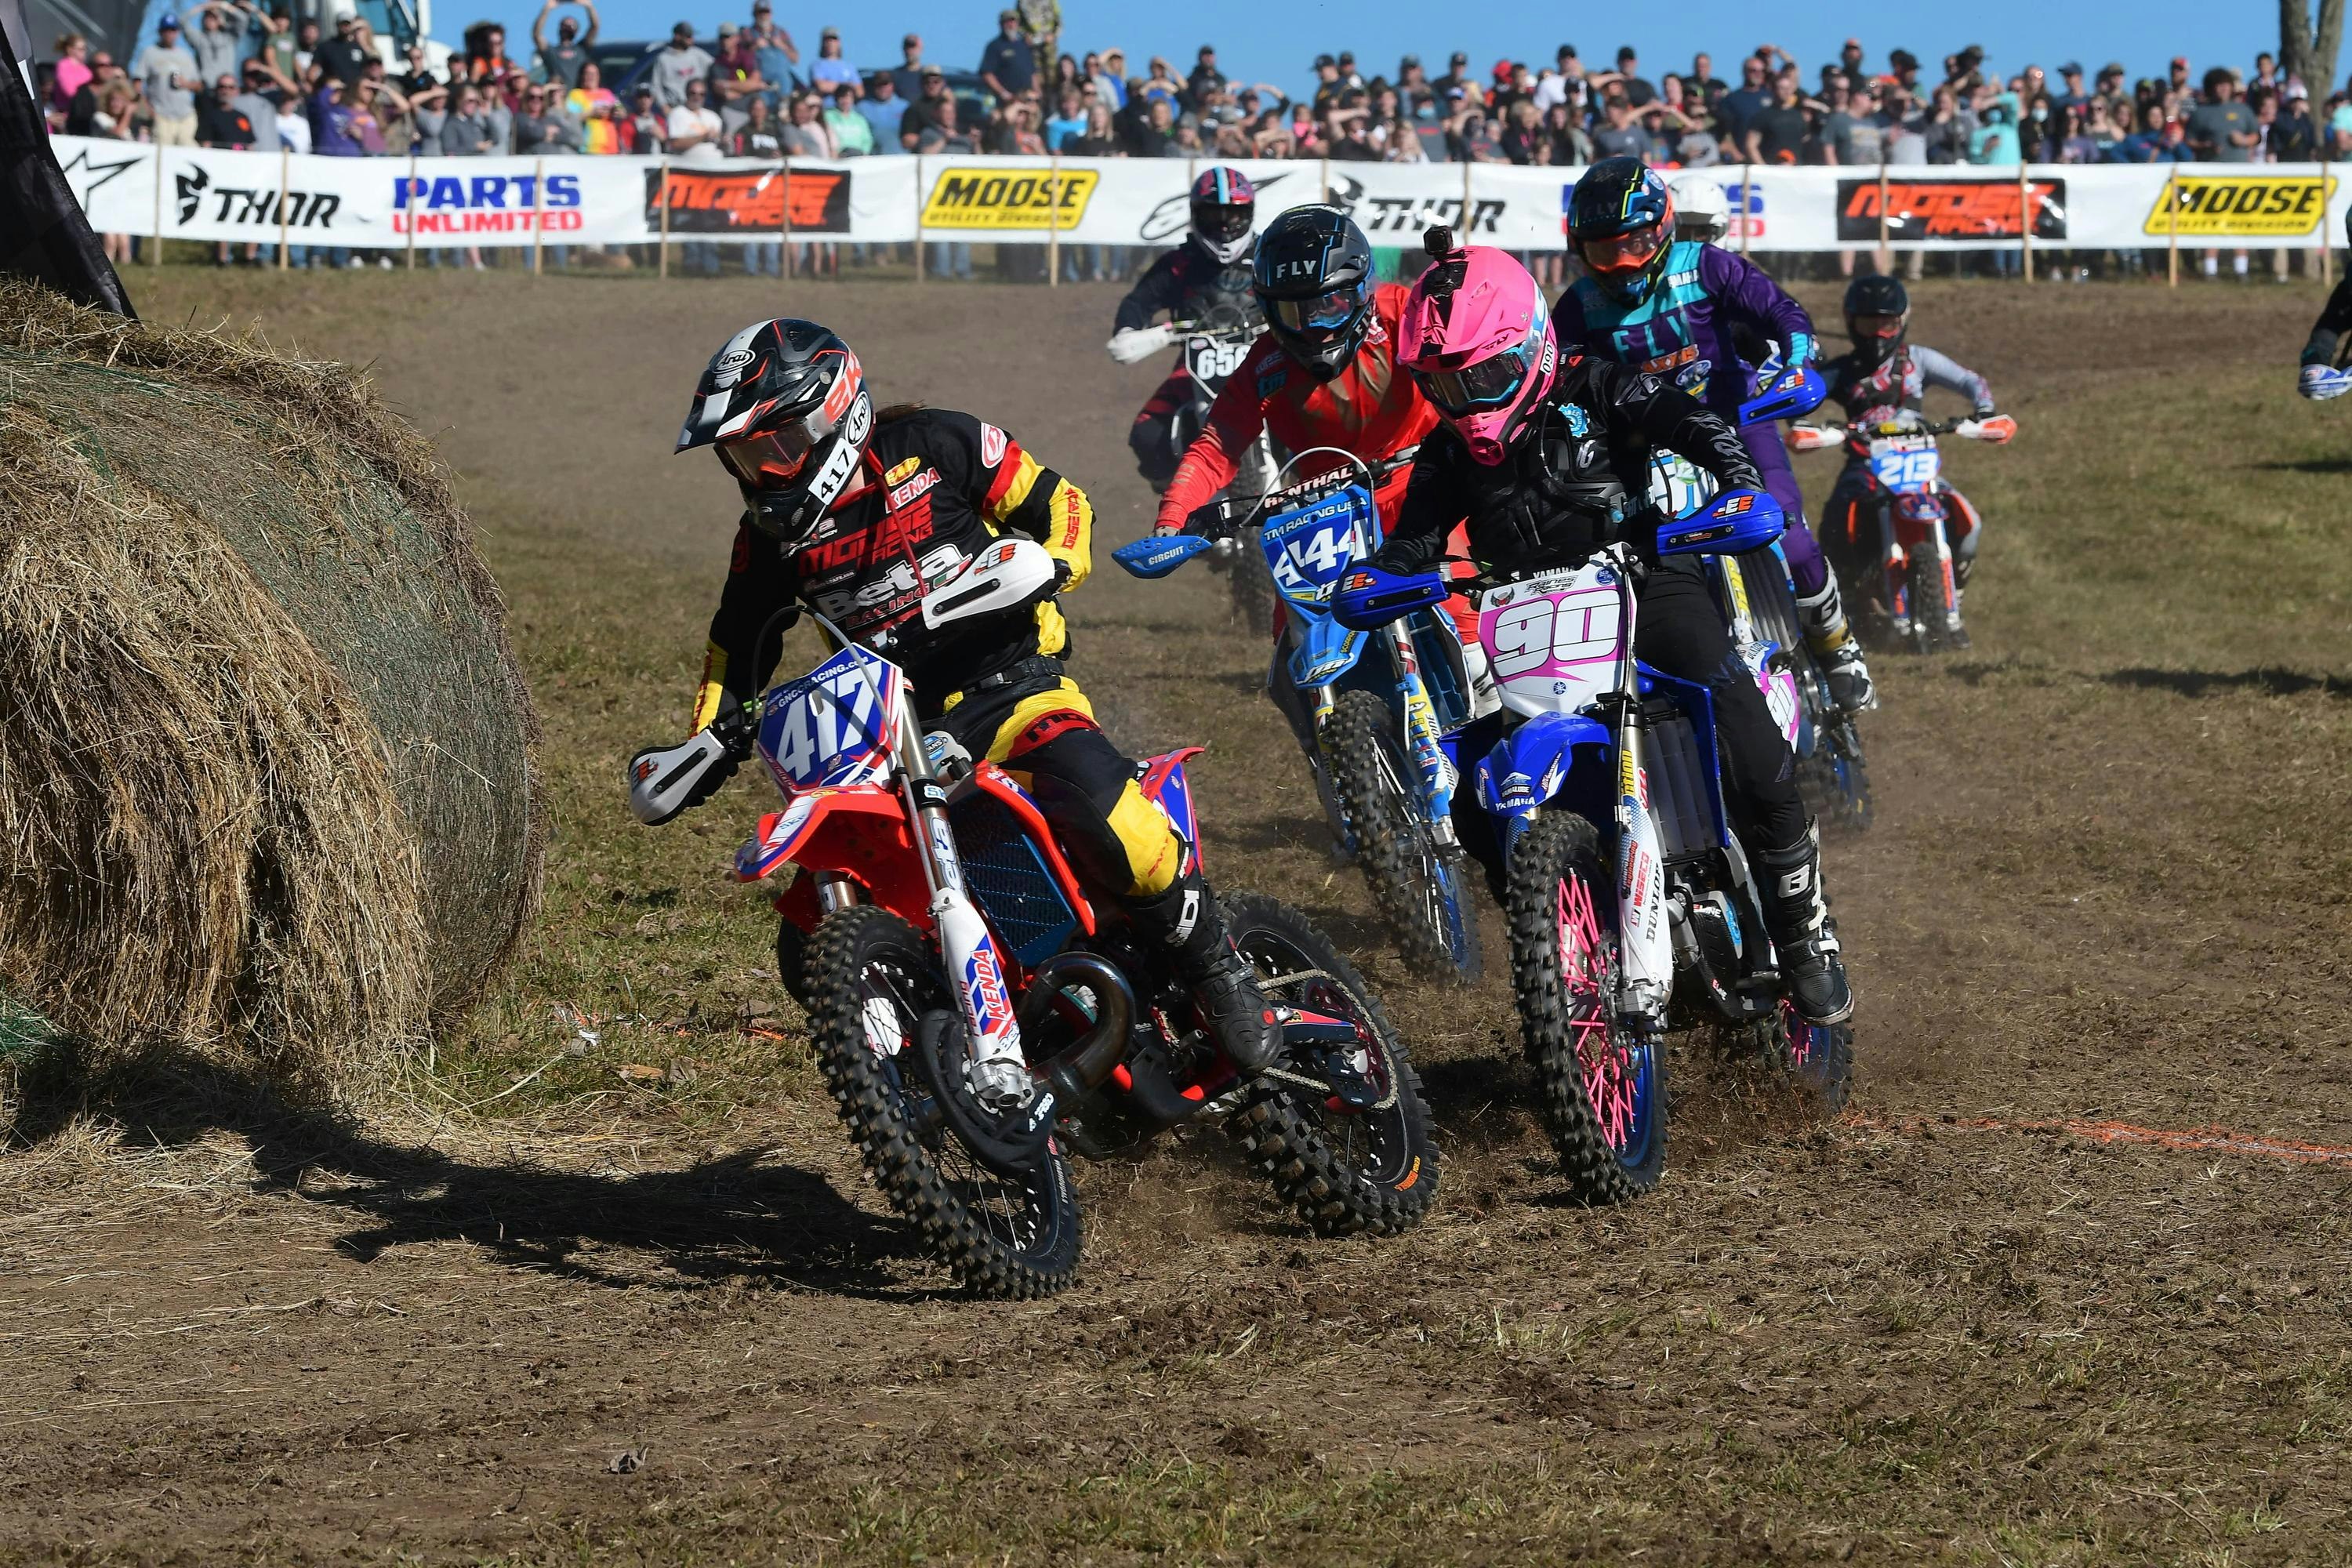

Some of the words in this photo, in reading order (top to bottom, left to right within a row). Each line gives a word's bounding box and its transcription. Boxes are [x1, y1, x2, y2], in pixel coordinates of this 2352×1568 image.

[213, 187, 339, 228] THOR
[394, 175, 581, 209] PARTS
[652, 173, 842, 211] MOOSE
[937, 178, 1085, 207] MOOSE
[1584, 201, 1619, 216] FLY
[1844, 184, 2056, 217] MOOSE
[2164, 186, 2325, 213] MOOSE
[394, 210, 583, 233] UNLIMITED
[728, 206, 827, 227] RACNG
[1369, 198, 1506, 233] THOR
[1925, 216, 2038, 234] RACIN
[1276, 260, 1316, 278] FLY
[1612, 310, 1690, 363] FLY
[720, 353, 750, 367] Arai
[853, 400, 868, 433] Arai
[819, 448, 851, 499] 417
[1878, 452, 1938, 486] 213
[886, 466, 942, 514] KENDA
[1337, 495, 1368, 514] USA
[1725, 495, 1755, 514] EE
[1148, 546, 1185, 565] CIRCUIT
[1273, 518, 1373, 587] 444
[815, 544, 964, 622] Beta
[1494, 589, 1621, 678] 90
[776, 660, 883, 782] 417
[1425, 713, 1457, 790] BRIDGETONE
[1495, 797, 1536, 811] YAMAHA
[930, 817, 964, 891] eta
[1645, 862, 1659, 943] DUNLOP
[971, 949, 1007, 1020] KENDA
[1000, 1022, 1021, 1051] Bet
